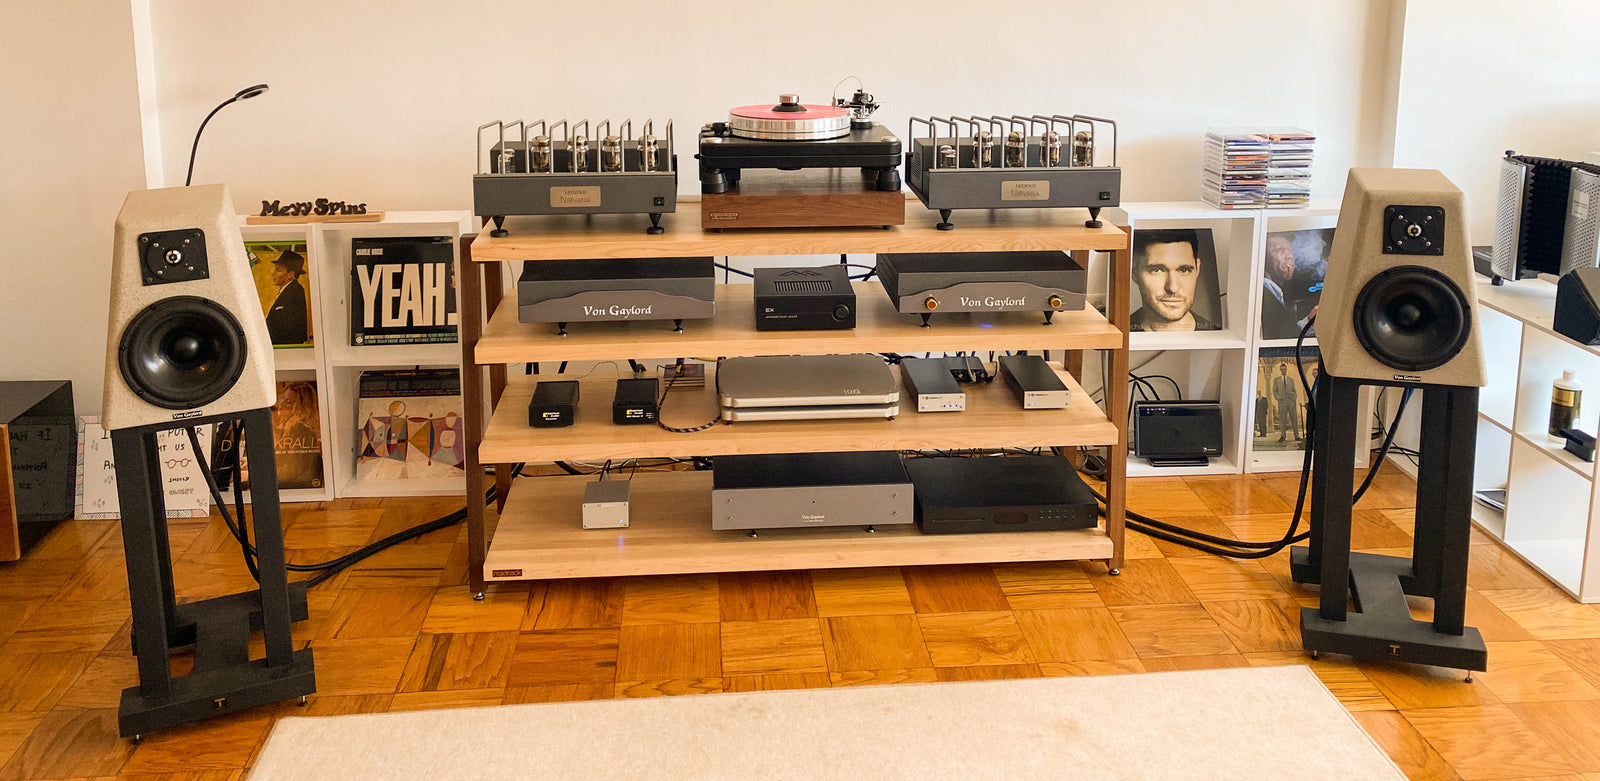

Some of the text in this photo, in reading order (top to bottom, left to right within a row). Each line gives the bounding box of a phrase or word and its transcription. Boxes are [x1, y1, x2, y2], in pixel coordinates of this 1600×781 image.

[314, 198, 367, 215] Spins
[960, 297, 1027, 309] Von Gaylord
[583, 304, 653, 319] Von Gaylord
[175, 443, 185, 451] US
